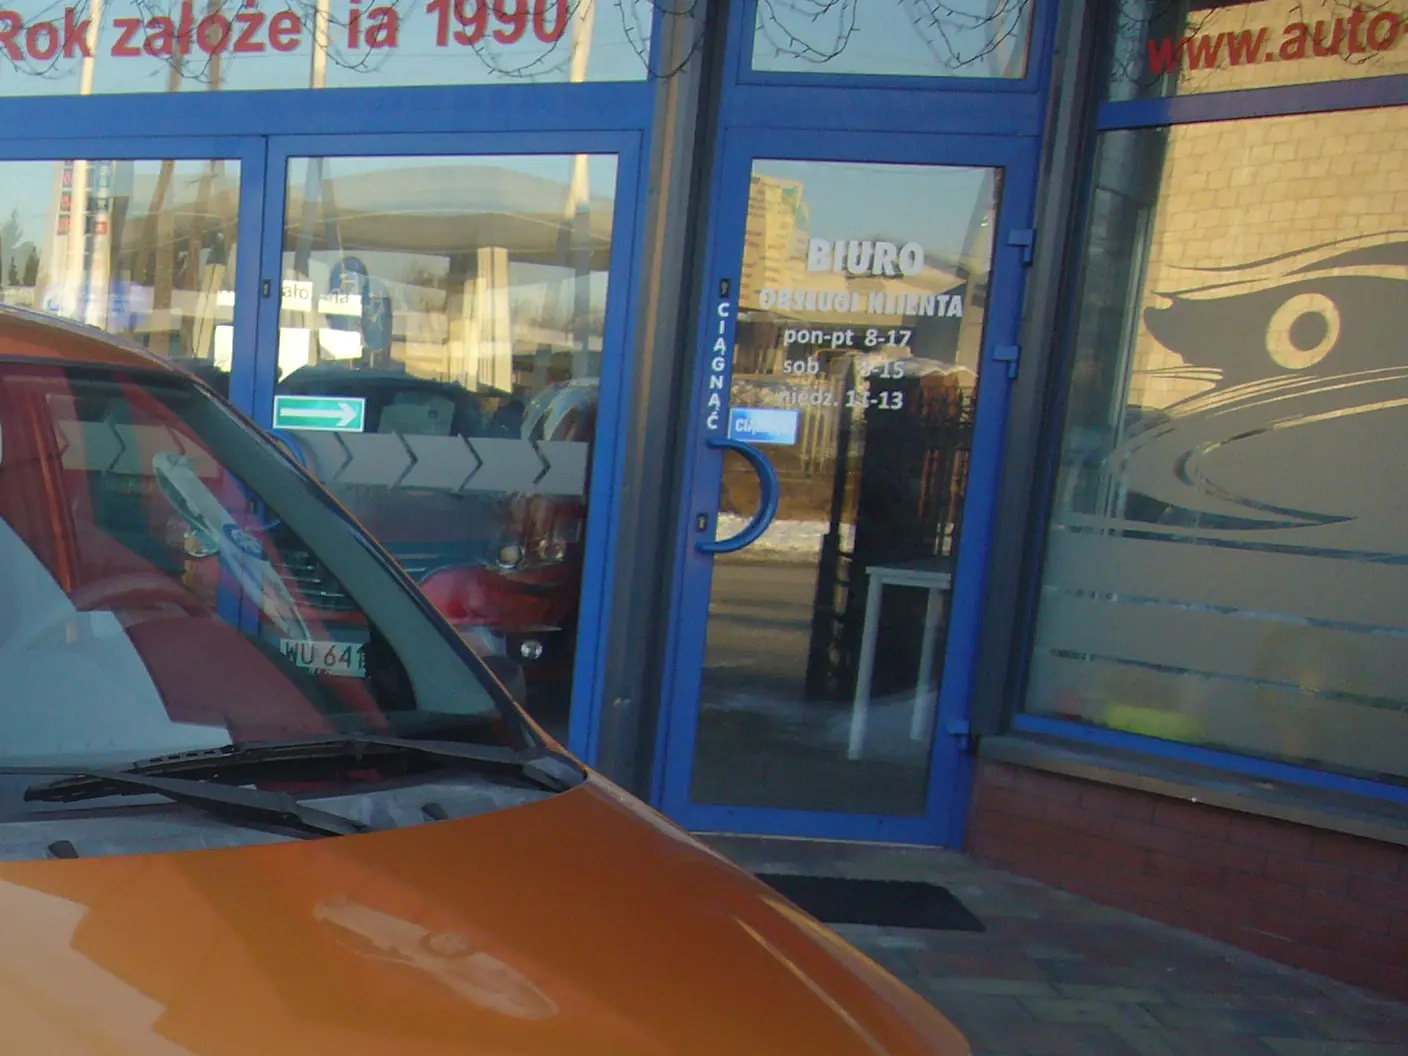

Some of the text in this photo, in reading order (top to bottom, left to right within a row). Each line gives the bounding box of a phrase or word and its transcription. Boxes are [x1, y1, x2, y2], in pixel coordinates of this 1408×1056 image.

[427, 0, 570, 47] 1990
[807, 238, 925, 277] BIURO
[868, 293, 963, 317] KLIENTA
[783, 328, 912, 348] pon-pt 8-17
[783, 356, 819, 375] sob
